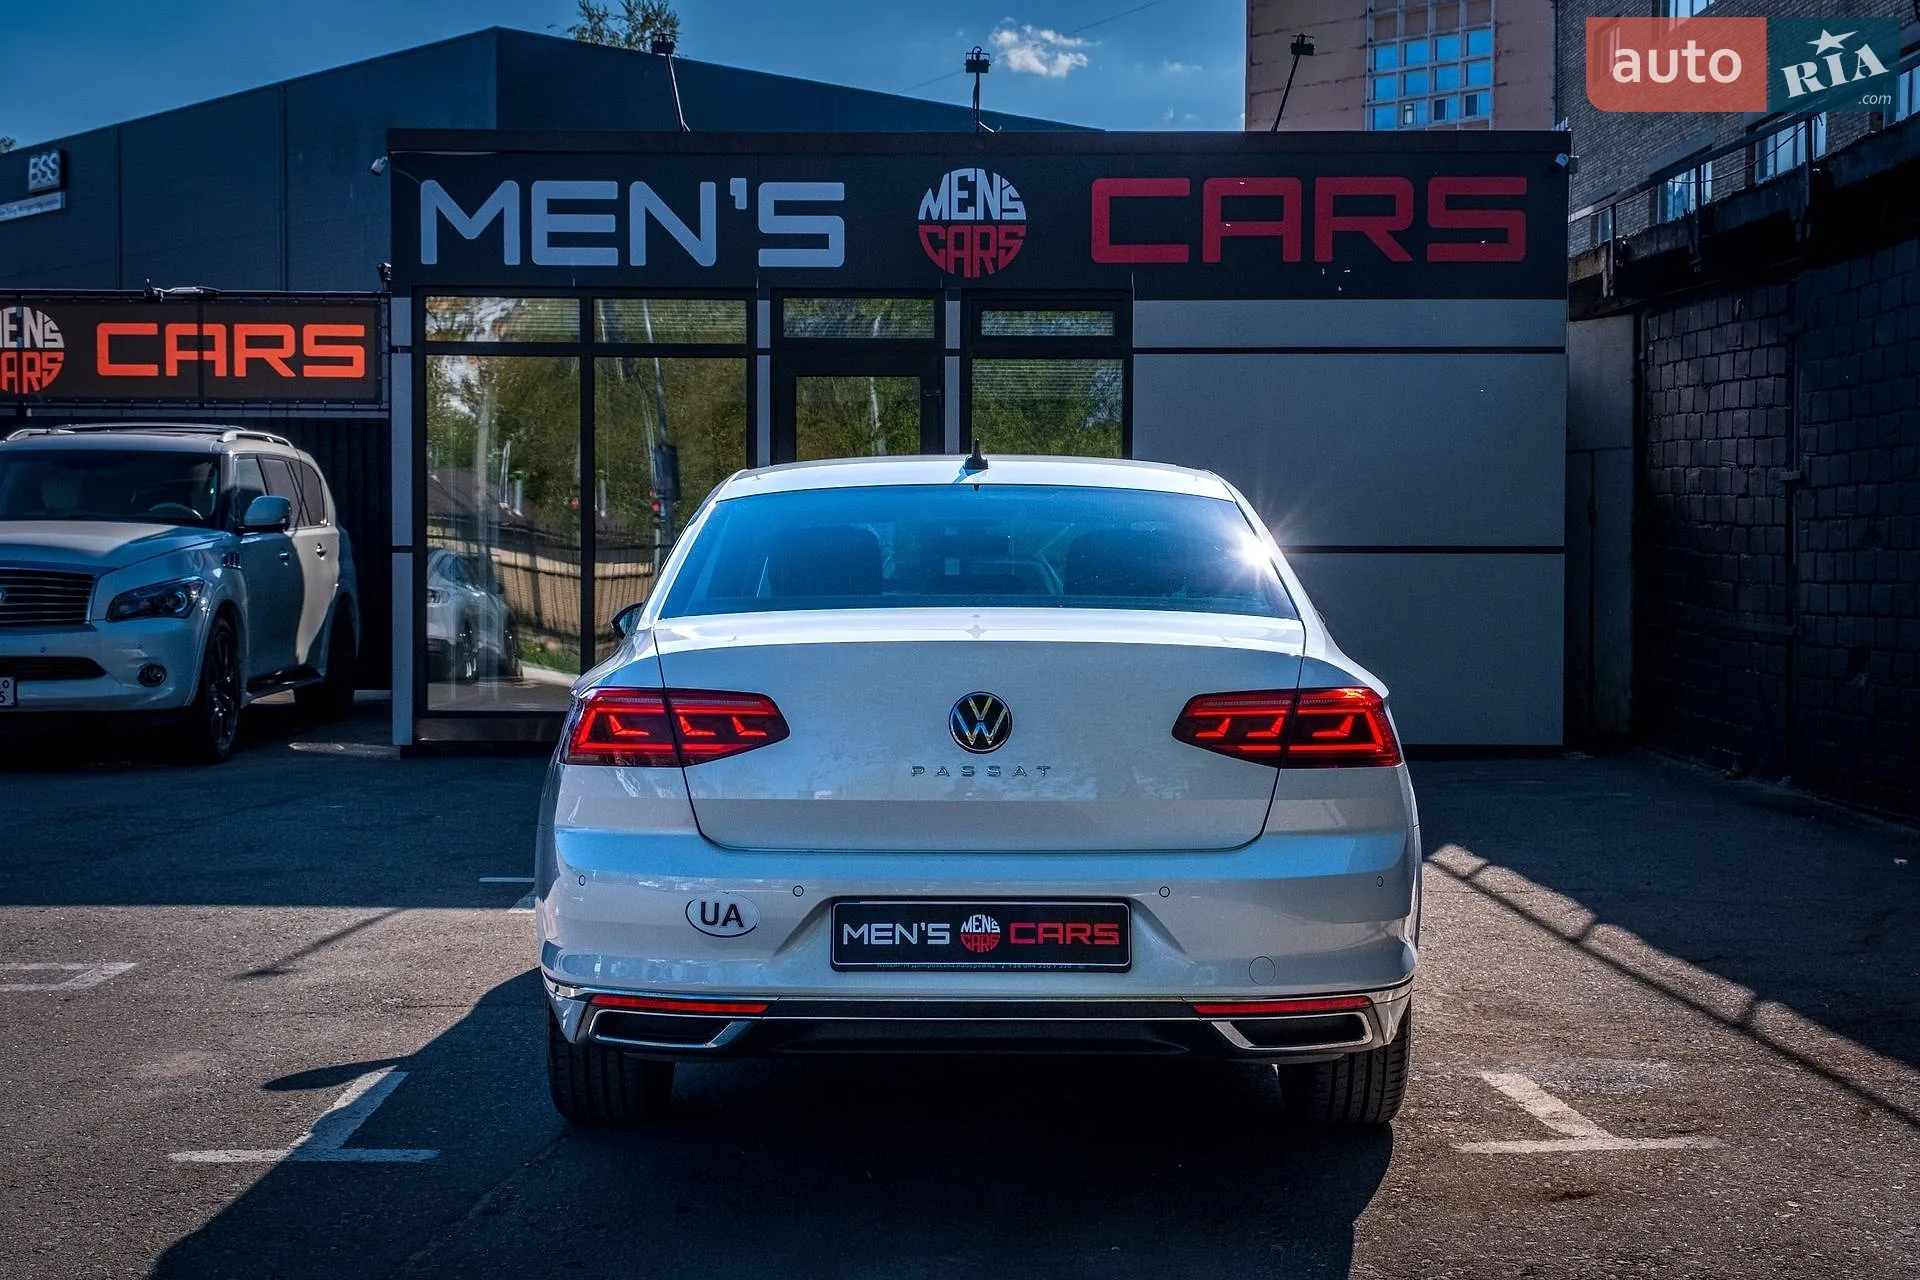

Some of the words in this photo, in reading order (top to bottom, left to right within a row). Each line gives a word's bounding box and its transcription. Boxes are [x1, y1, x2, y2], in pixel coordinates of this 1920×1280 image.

[918, 168, 1027, 221] MEN'S
[420, 178, 845, 267] MEN'S
[1091, 176, 1527, 263] CARS
[918, 225, 1027, 278] CARS
[0, 306, 65, 348] EN'S
[96, 322, 366, 378] CARS
[0, 351, 65, 394] ARS
[911, 765, 1051, 777] PASSAT
[700, 901, 745, 928] UA
[960, 914, 1001, 933] MEN'S
[843, 922, 950, 945] MEN'S
[1009, 922, 1120, 945] CARS
[960, 933, 1001, 953] CARS
